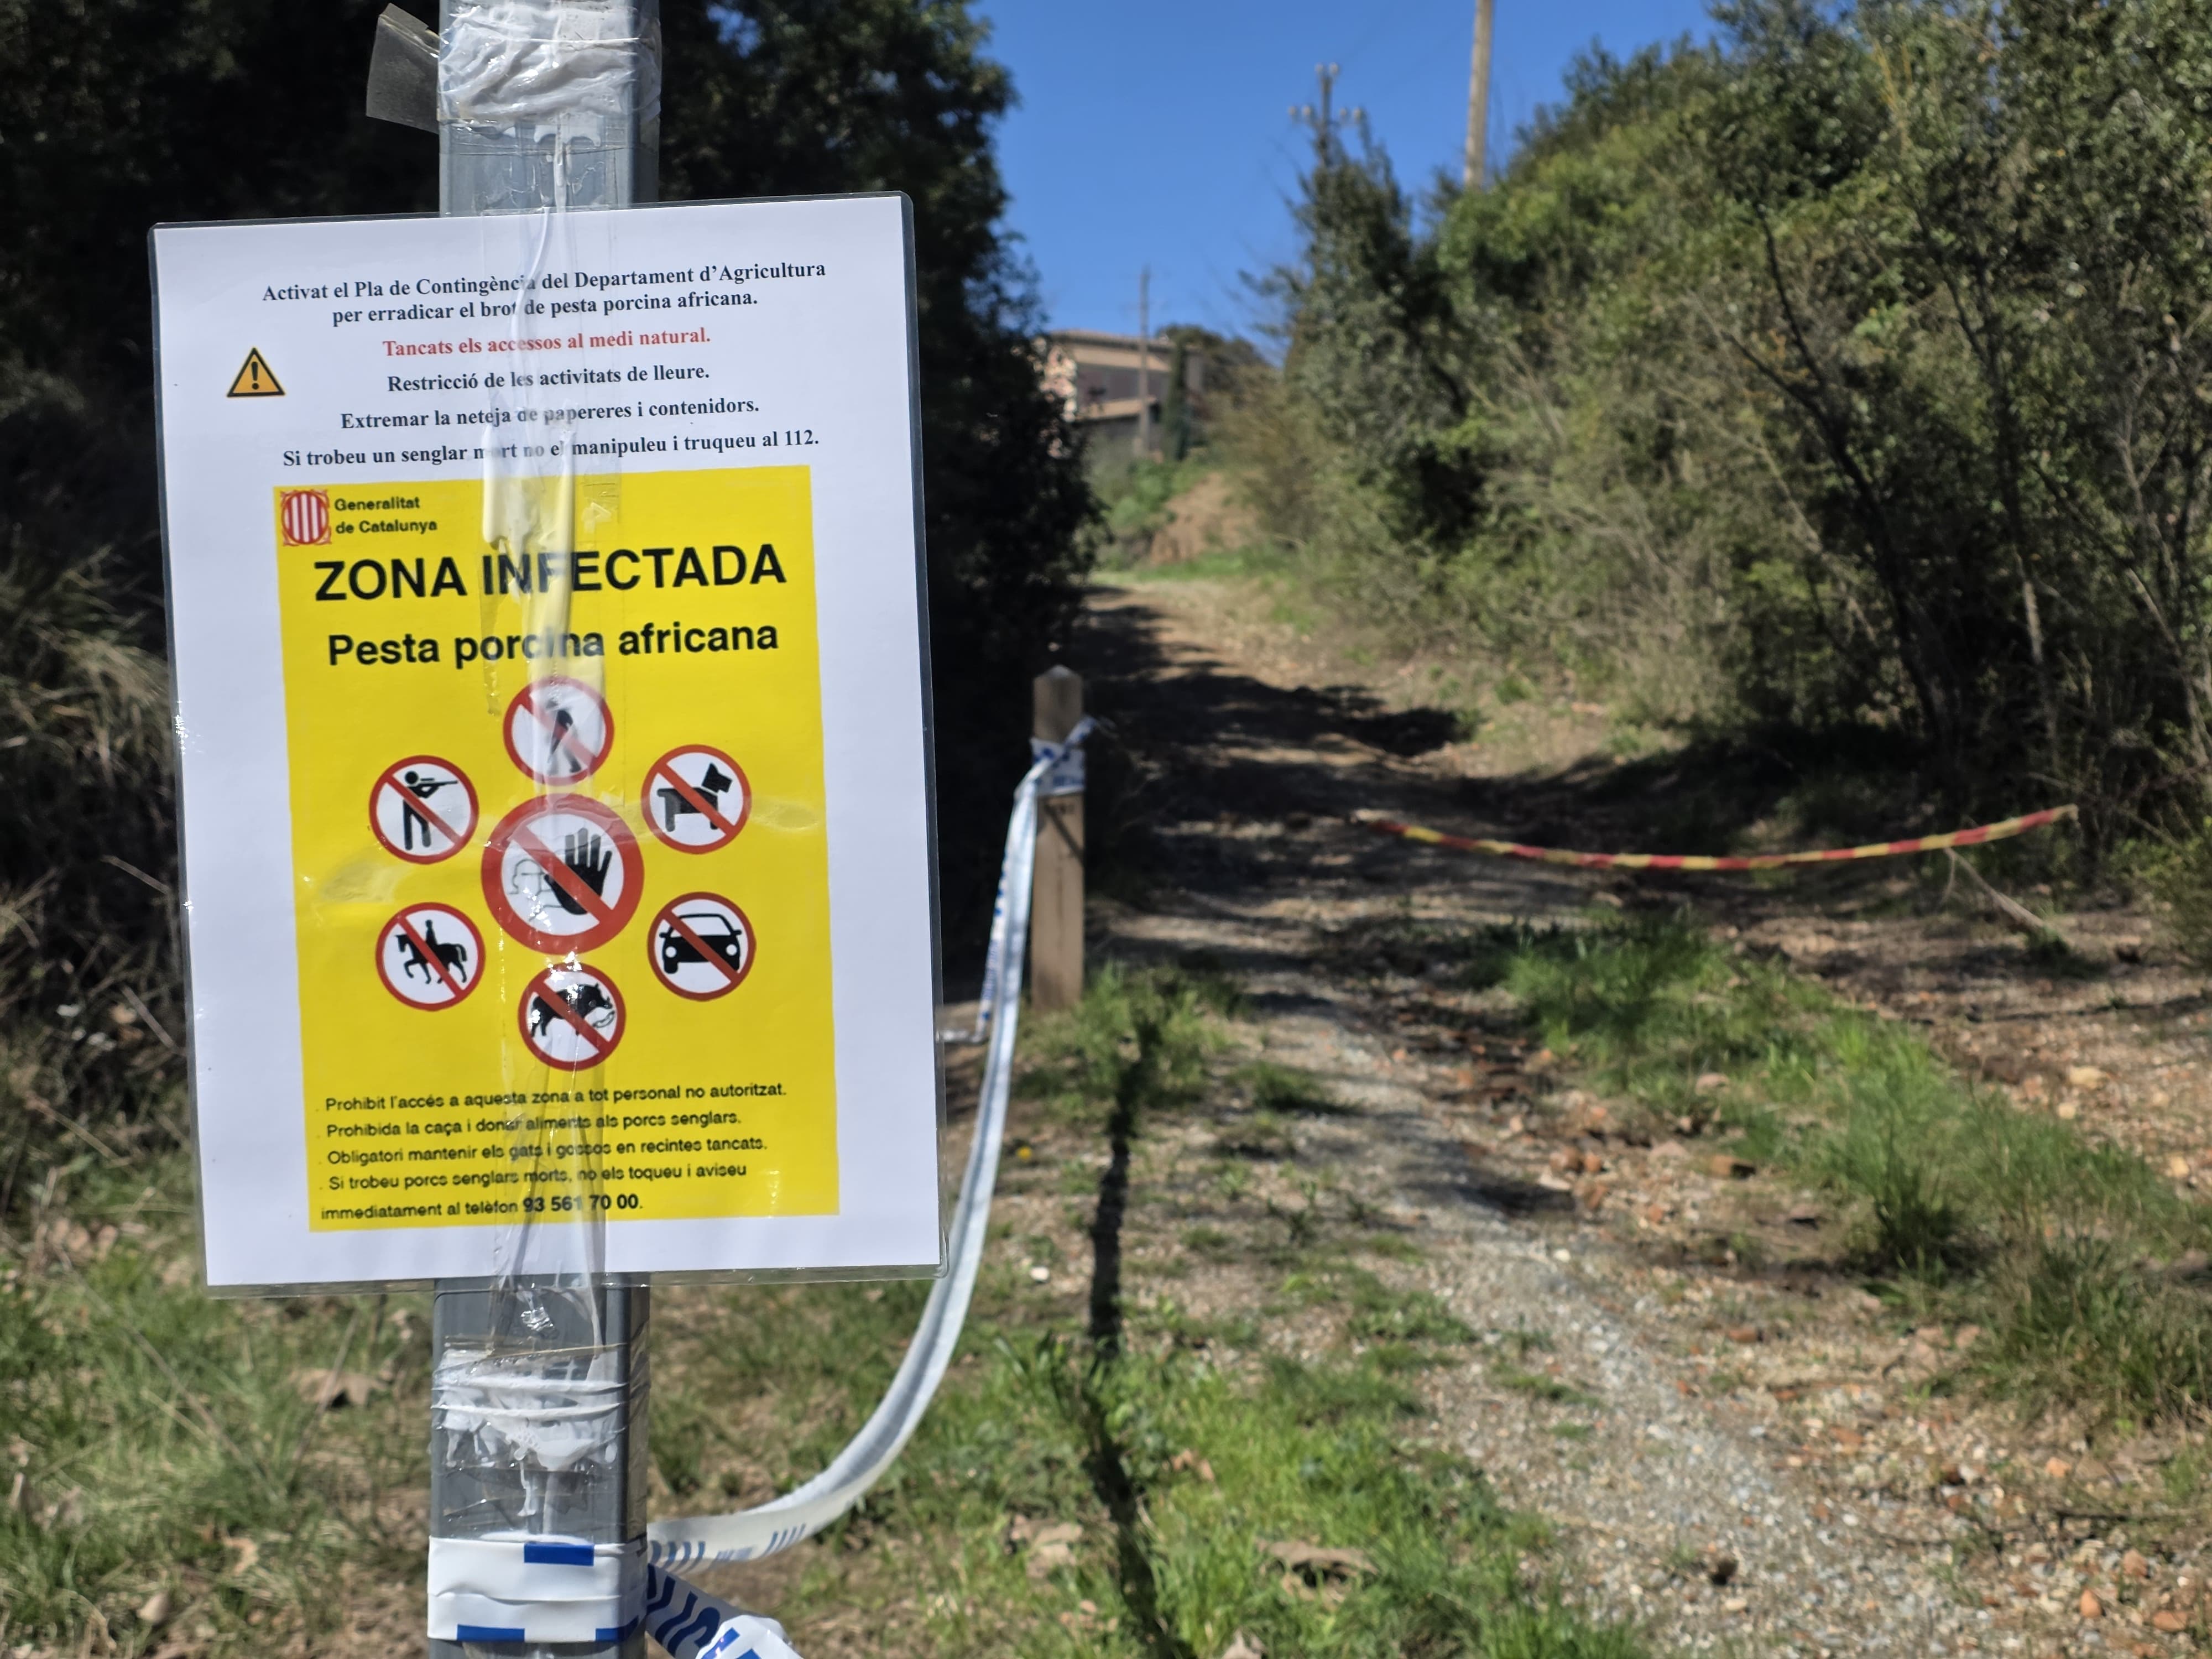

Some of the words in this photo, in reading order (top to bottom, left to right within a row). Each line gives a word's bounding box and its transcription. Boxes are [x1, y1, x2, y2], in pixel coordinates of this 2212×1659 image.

[263, 284, 328, 301] Activat
[333, 282, 348, 298] el
[354, 281, 383, 298] Pla
[389, 279, 410, 296] de
[542, 274, 568, 288] del
[574, 268, 694, 290] Departament
[332, 310, 362, 327] per
[368, 304, 453, 321] erradicar
[460, 301, 474, 317] el
[525, 299, 544, 314] de
[551, 298, 597, 317] pesta
[603, 295, 671, 316] porcina
[677, 291, 758, 308] africana.
[383, 340, 452, 356] Tancats
[458, 338, 481, 353] els
[488, 338, 561, 352] accessos
[567, 333, 583, 349] al
[589, 330, 633, 348] medi
[639, 327, 711, 345] natural.
[387, 374, 478, 392] Restricció
[484, 372, 504, 388] de
[510, 372, 534, 387] les
[540, 367, 621, 385] activitats
[627, 366, 648, 382] de
[654, 364, 709, 380] lleure.
[341, 411, 429, 429] Extremar
[434, 409, 450, 425] la
[457, 407, 510, 427] neteja
[517, 407, 538, 421] de
[544, 403, 632, 425] papereres
[638, 403, 644, 416] i
[649, 397, 759, 416] contenidors.
[284, 450, 300, 466] Si
[307, 447, 366, 465] trobeu
[373, 451, 395, 462] un
[401, 446, 467, 465] senglar
[523, 444, 545, 457] no
[571, 436, 666, 458] manipuleu
[672, 436, 679, 450] i
[684, 434, 755, 453] truqueu
[762, 431, 778, 447] al
[785, 429, 819, 446] 112.
[334, 497, 420, 511] Generalitat
[336, 521, 354, 534] de
[359, 519, 437, 535] Catalunya
[315, 556, 468, 601] ZONA
[483, 544, 787, 594] INFECTADA
[328, 634, 440, 666] Pesta
[455, 628, 604, 666] porcina
[619, 622, 778, 655] africana
[326, 1096, 385, 1110] Prohibit
[450, 1096, 459, 1106] a
[465, 1092, 526, 1108] aquesta
[532, 1092, 569, 1103] zona
[575, 1092, 584, 1101] a
[589, 1089, 608, 1100] tot
[613, 1085, 680, 1103] personal
[686, 1088, 705, 1098] no
[710, 1083, 786, 1097] autoritzat.
[327, 1123, 400, 1137] Prohibida
[406, 1121, 419, 1135] la
[425, 1121, 461, 1136] caça
[467, 1119, 471, 1131] i
[476, 1118, 521, 1132] donar
[526, 1115, 591, 1129] aliments
[596, 1115, 619, 1128] als
[623, 1115, 666, 1130] porcs
[671, 1110, 740, 1128] senglars.
[327, 1148, 403, 1166] Obligatori
[408, 1145, 477, 1161] mantenir
[482, 1145, 504, 1158] els
[509, 1144, 543, 1161] gats
[547, 1142, 551, 1156] i
[556, 1143, 611, 1159] gossos
[617, 1142, 635, 1154] en
[641, 1138, 702, 1152] recintes
[707, 1136, 766, 1150] tancats.
[329, 1177, 344, 1190] Si
[349, 1175, 399, 1188] trobeu
[404, 1175, 447, 1190] porcs
[452, 1170, 519, 1187] senglars
[577, 1170, 597, 1180] no
[601, 1167, 624, 1180] els
[629, 1165, 682, 1181] toqueu
[687, 1164, 691, 1177] i
[696, 1164, 747, 1177] aviseu
[322, 1203, 442, 1220] immediatament
[447, 1202, 461, 1214] al
[465, 1199, 518, 1214] telèfon
[523, 1197, 545, 1212] 93
[551, 1194, 583, 1211] 561
[589, 1194, 611, 1209] 70
